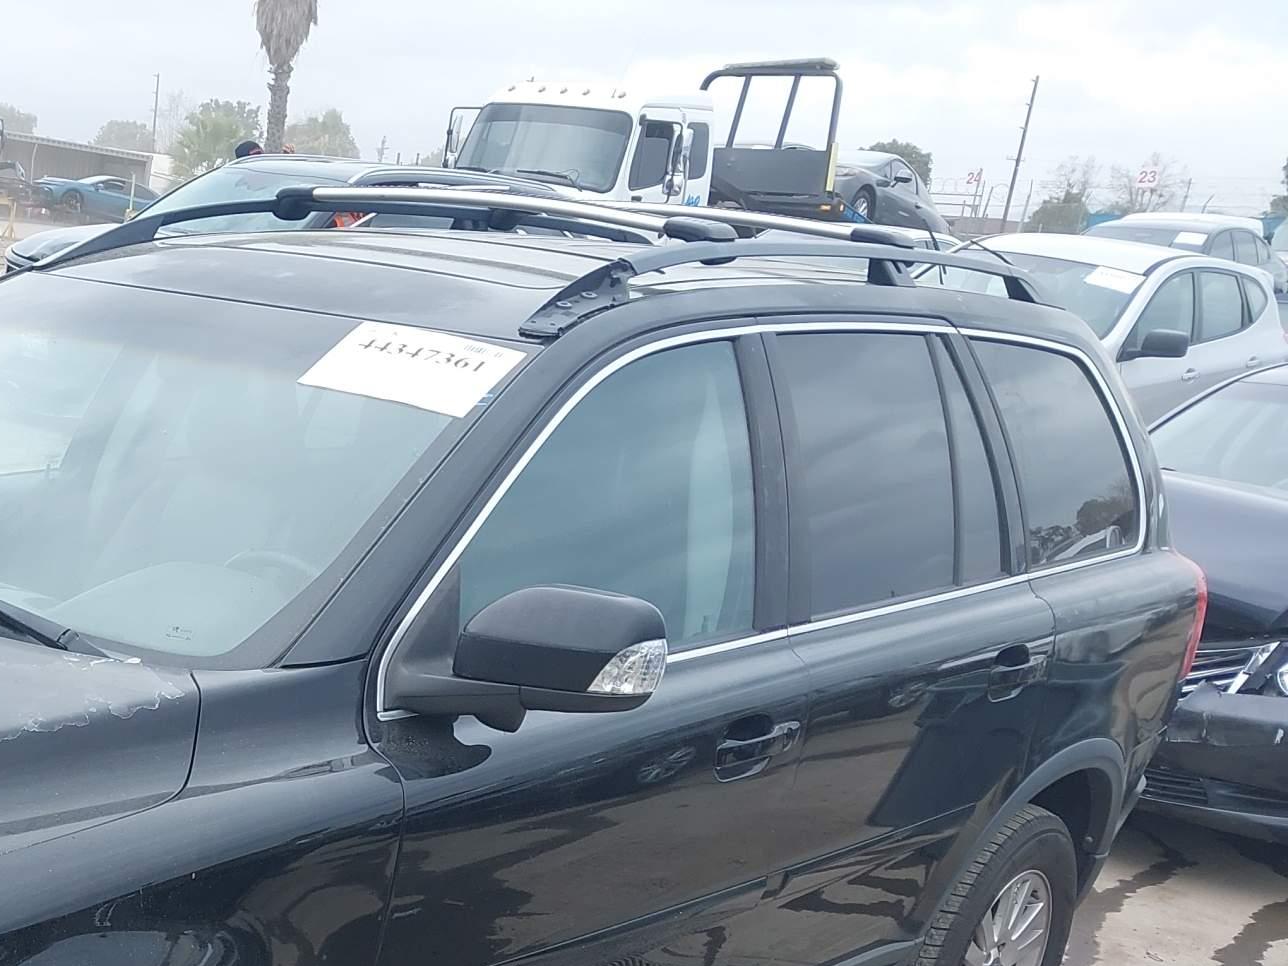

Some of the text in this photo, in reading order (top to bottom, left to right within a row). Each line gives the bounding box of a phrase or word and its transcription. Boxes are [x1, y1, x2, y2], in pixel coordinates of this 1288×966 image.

[966, 171, 983, 185] 24
[1138, 170, 1157, 184] 23
[357, 339, 486, 373] 44347361
